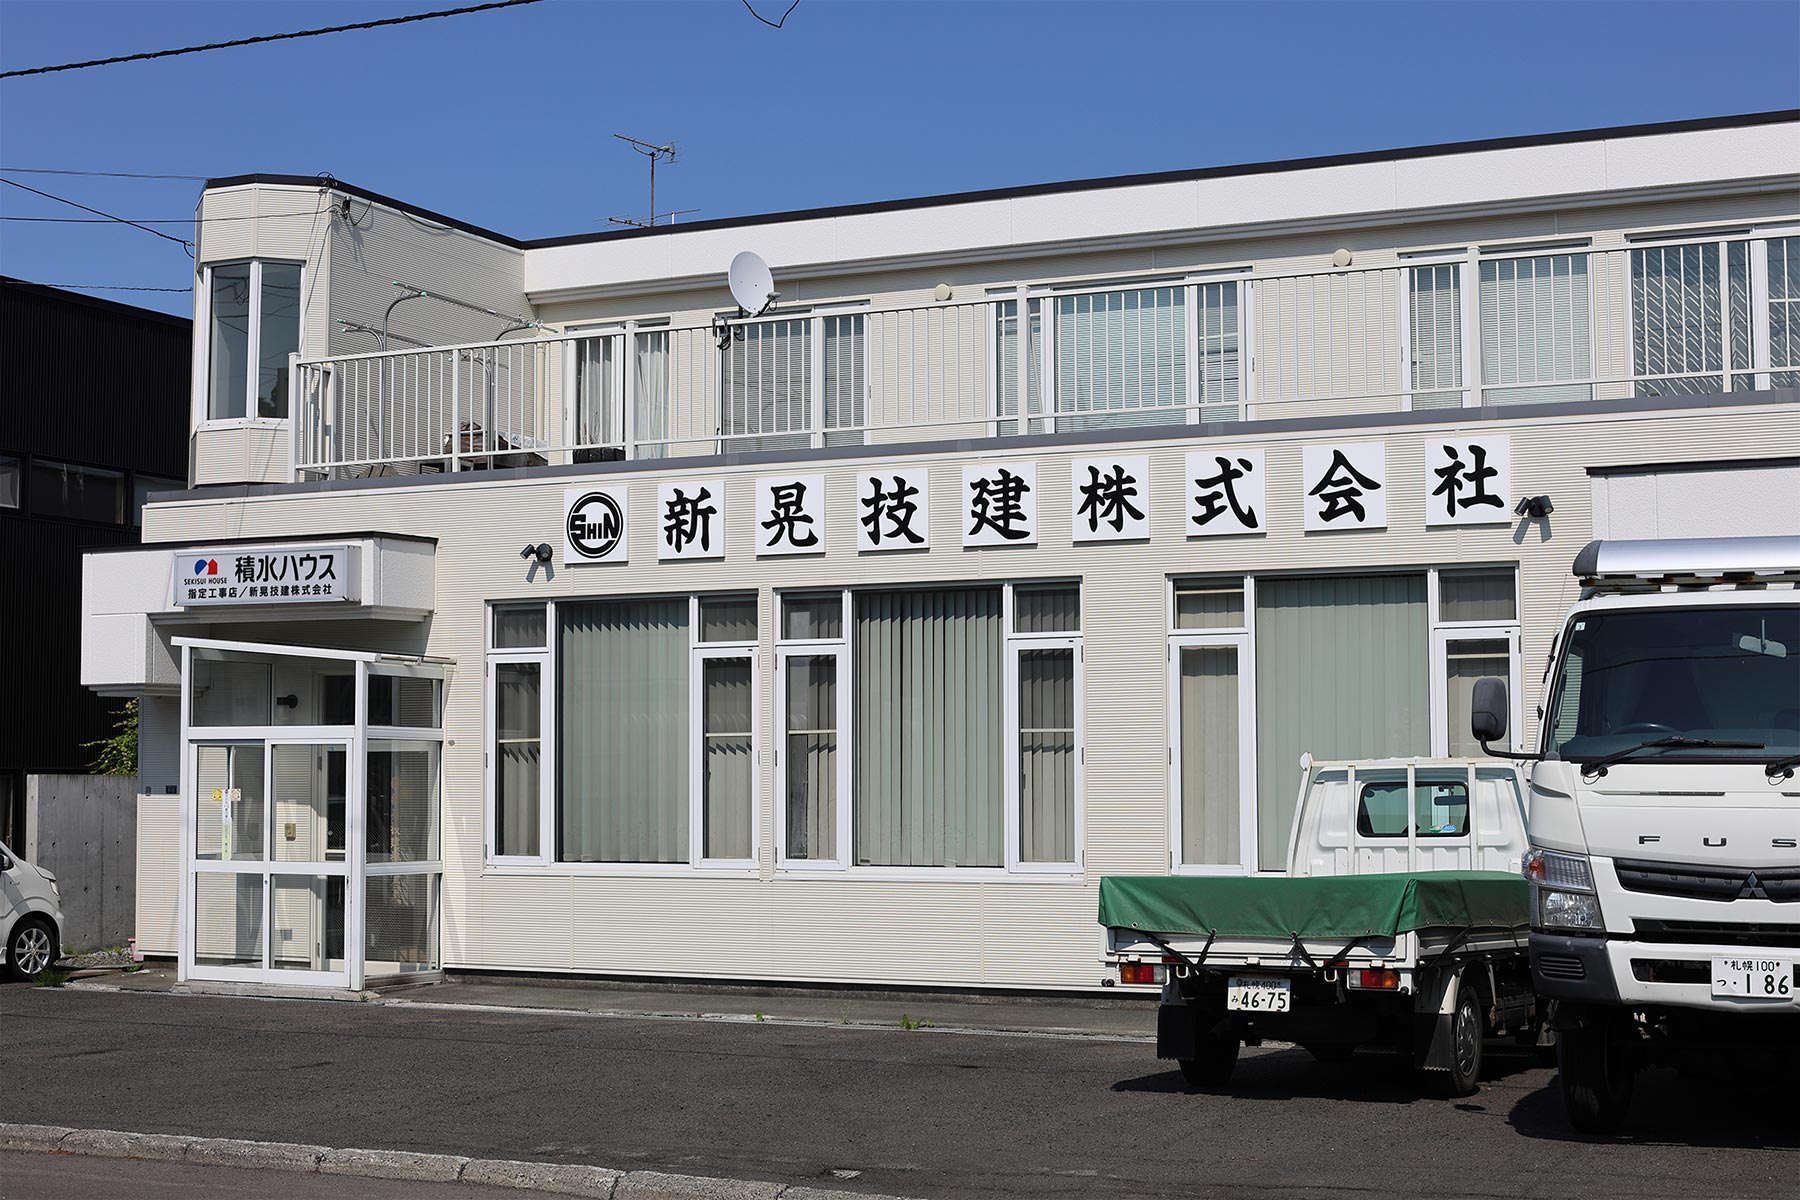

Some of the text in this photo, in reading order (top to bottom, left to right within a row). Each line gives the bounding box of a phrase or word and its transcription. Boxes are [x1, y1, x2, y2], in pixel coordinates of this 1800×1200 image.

[664, 445, 1504, 553] 新晃技建株式会社
[570, 513, 615, 540] SHIN
[235, 554, 336, 583] 積水ハウス
[183, 577, 228, 586] SEKISUI HOUSE
[1730, 960, 1775, 972] 札幌100
[1240, 991, 1287, 1009] 46-75
